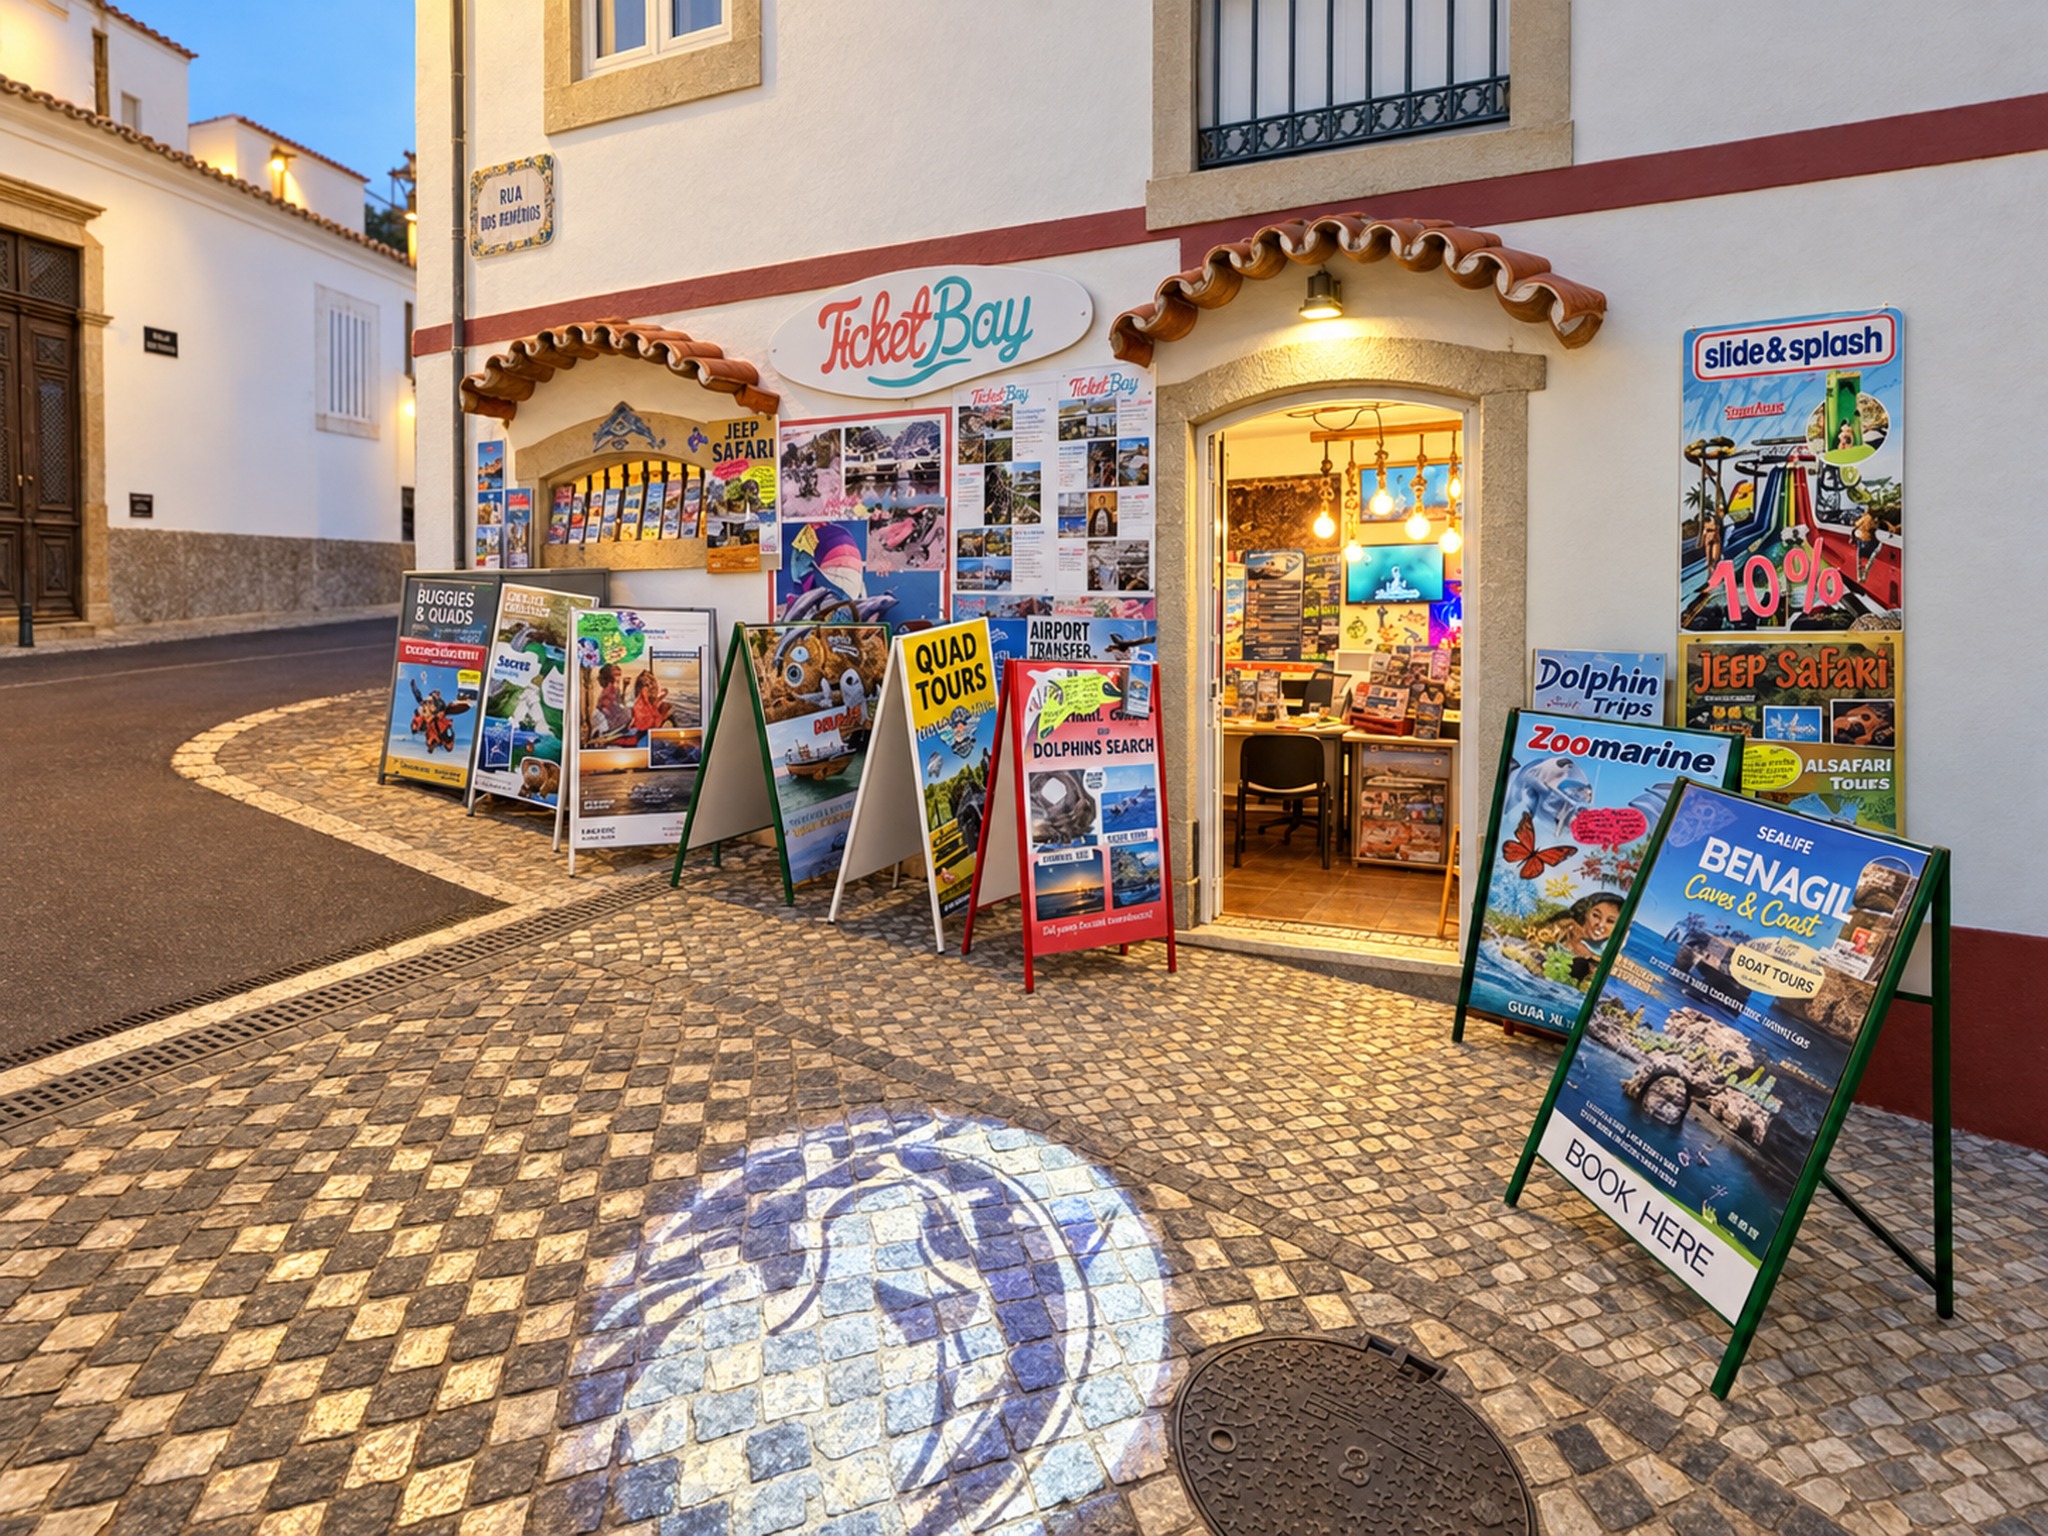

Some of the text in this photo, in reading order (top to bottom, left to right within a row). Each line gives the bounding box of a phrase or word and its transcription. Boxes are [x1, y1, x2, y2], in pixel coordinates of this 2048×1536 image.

[500, 185, 523, 205] RUA
[481, 214, 497, 232] DOS
[724, 420, 760, 440] JEEP
[712, 438, 775, 463] SAFARI
[1707, 537, 1844, 622] 10%
[416, 588, 475, 609] BUGGIES
[415, 608, 474, 626] & QUADS
[1029, 620, 1091, 642] AIRPORT
[914, 632, 978, 675] QUAD
[915, 661, 988, 711] TOURS
[1535, 657, 1659, 702] Dolphin
[1592, 696, 1654, 721] Trips
[1033, 737, 1155, 760] DOLPHINS SEARCH
[1526, 724, 1717, 774] Zoomarine
[1756, 825, 1815, 856] SEALIFE
[1698, 836, 1854, 924] BENAGIL
[1684, 873, 1825, 939] Caves & Coast
[1736, 953, 1816, 995] BOAT TOURS
[1564, 1138, 1638, 1214] BOOK
[1637, 1200, 1716, 1279] HERE
